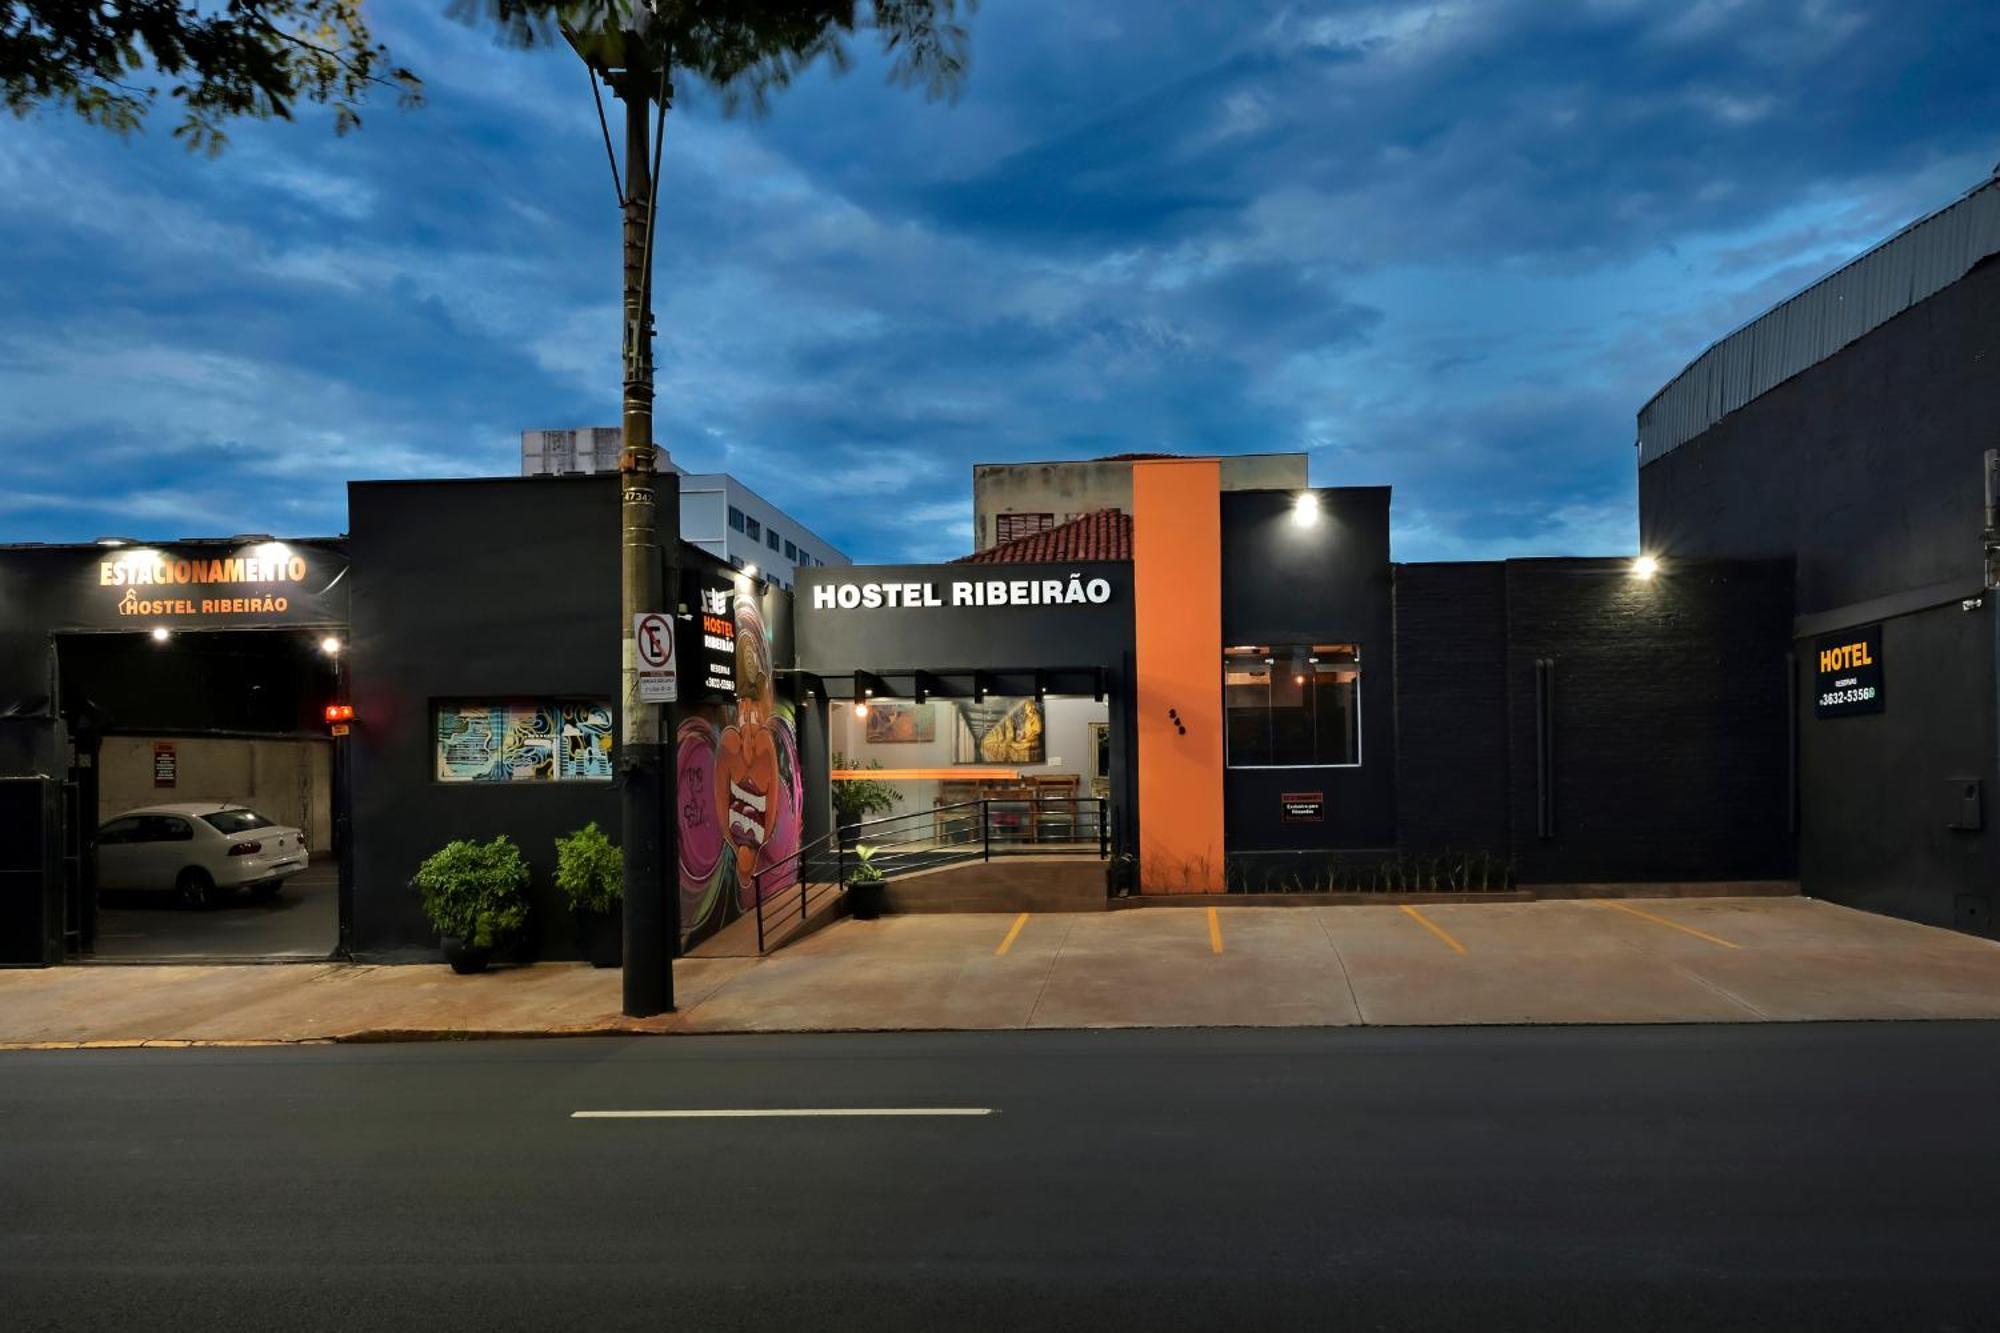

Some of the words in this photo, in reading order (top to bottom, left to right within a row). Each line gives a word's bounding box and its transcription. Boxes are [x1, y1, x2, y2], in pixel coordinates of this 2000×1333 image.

[100, 556, 306, 586] ESTACIONAMENTO
[813, 583, 942, 609] HOSTEL
[952, 572, 1111, 606] RIBEIRÃO
[126, 600, 196, 614] HOSTEL
[202, 594, 287, 613] RIBEIRÃO
[703, 615, 734, 638] HOSTEL
[1820, 642, 1872, 673] HOTEL
[1823, 687, 1869, 706] 3632-5356
